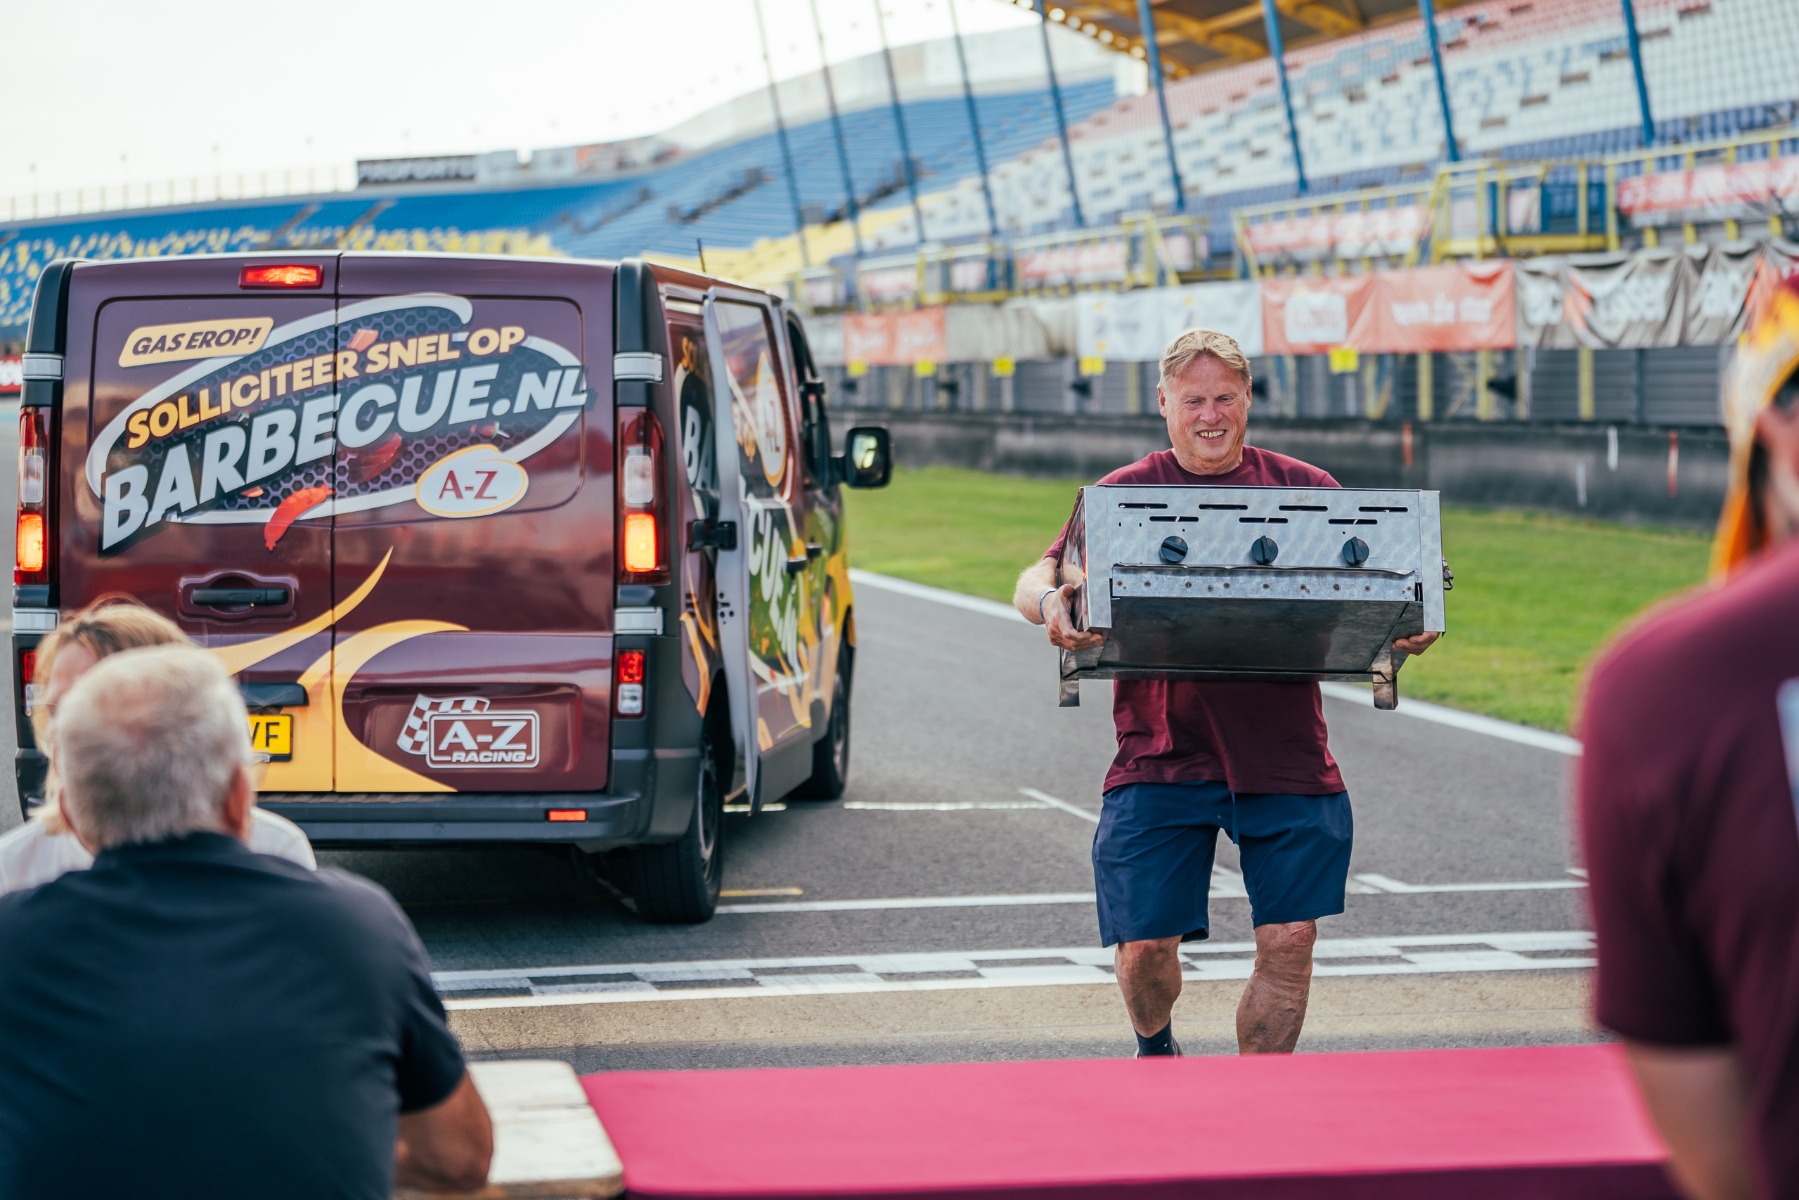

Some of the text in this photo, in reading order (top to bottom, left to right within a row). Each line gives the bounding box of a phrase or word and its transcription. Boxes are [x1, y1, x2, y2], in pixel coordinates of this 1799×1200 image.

[132, 327, 262, 356] GAS EROP!
[127, 326, 525, 449] SOLLICITEER SNEL OP
[102, 363, 588, 551] BARBECUE.NL
[438, 470, 499, 500] A-Z
[438, 720, 528, 750] A-Z
[451, 751, 527, 763] RACING
